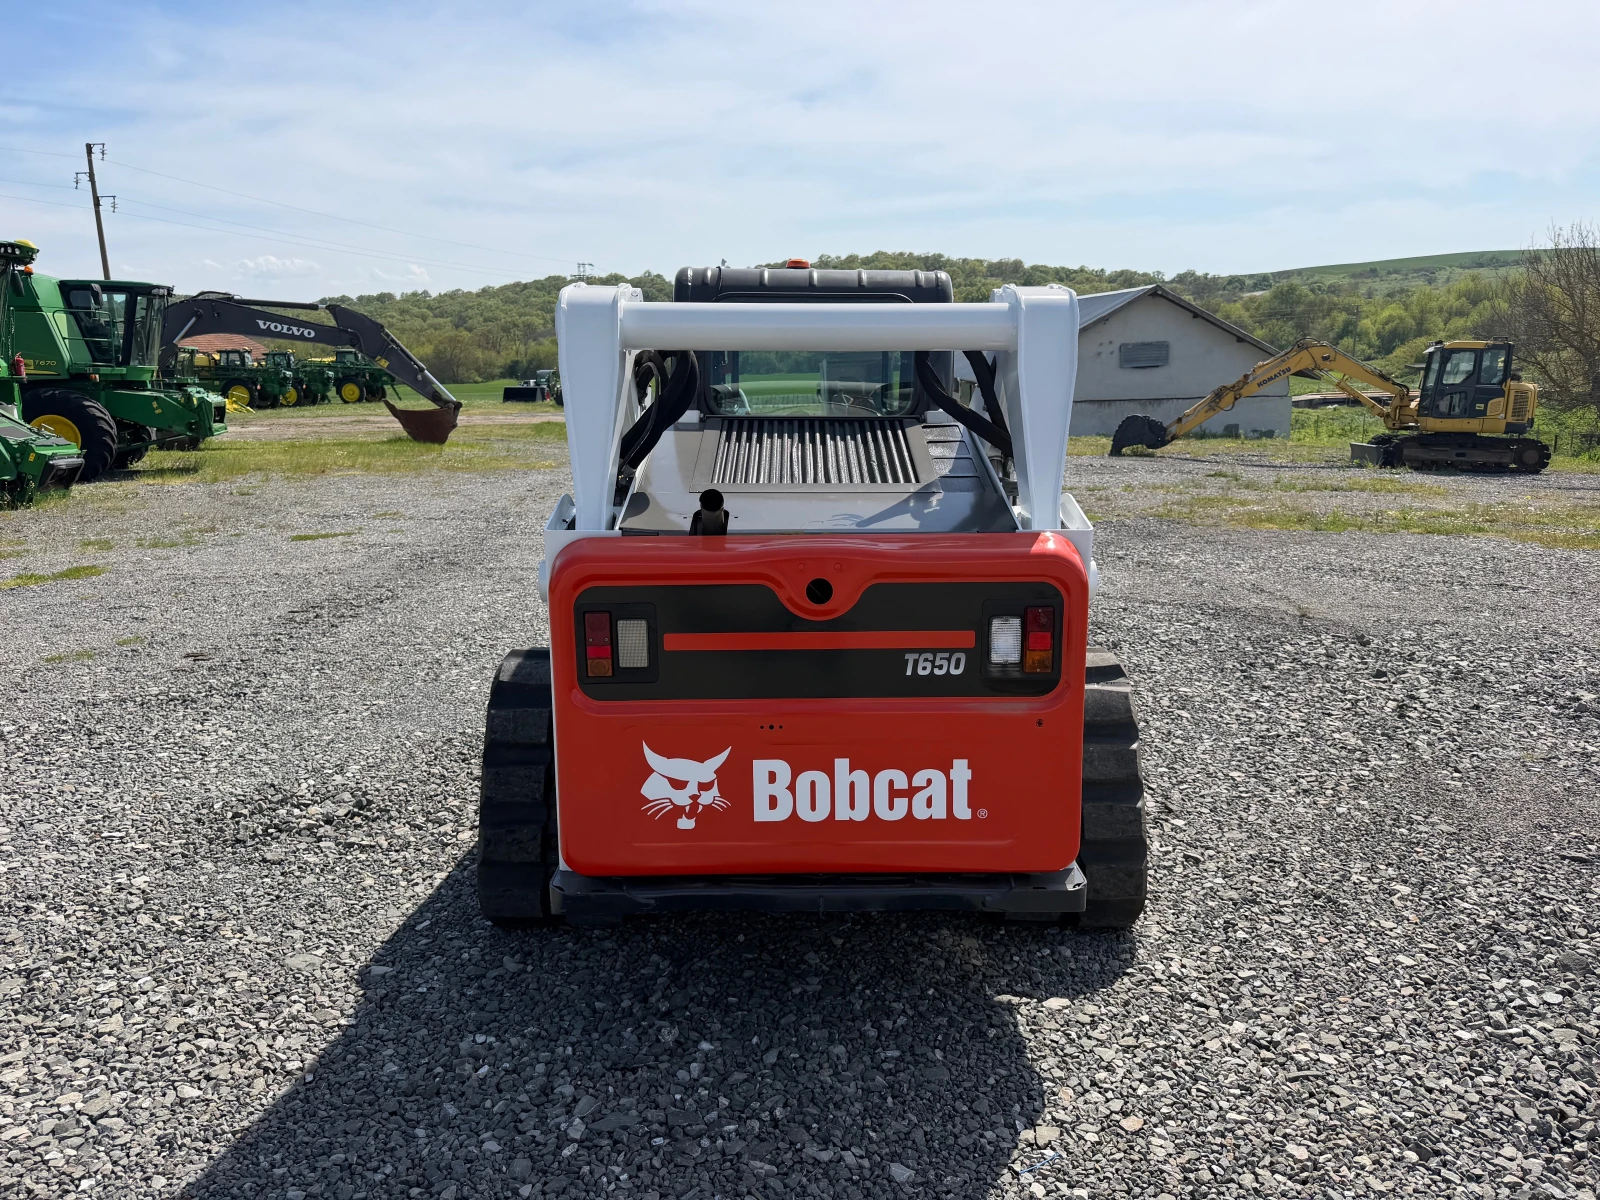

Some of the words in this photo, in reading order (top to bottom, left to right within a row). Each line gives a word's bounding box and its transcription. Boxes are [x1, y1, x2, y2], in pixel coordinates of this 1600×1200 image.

[256, 319, 316, 338] VOLVO
[1256, 366, 1292, 388] KOMATSU
[904, 652, 967, 676] T650
[752, 757, 972, 822] Bobcat
